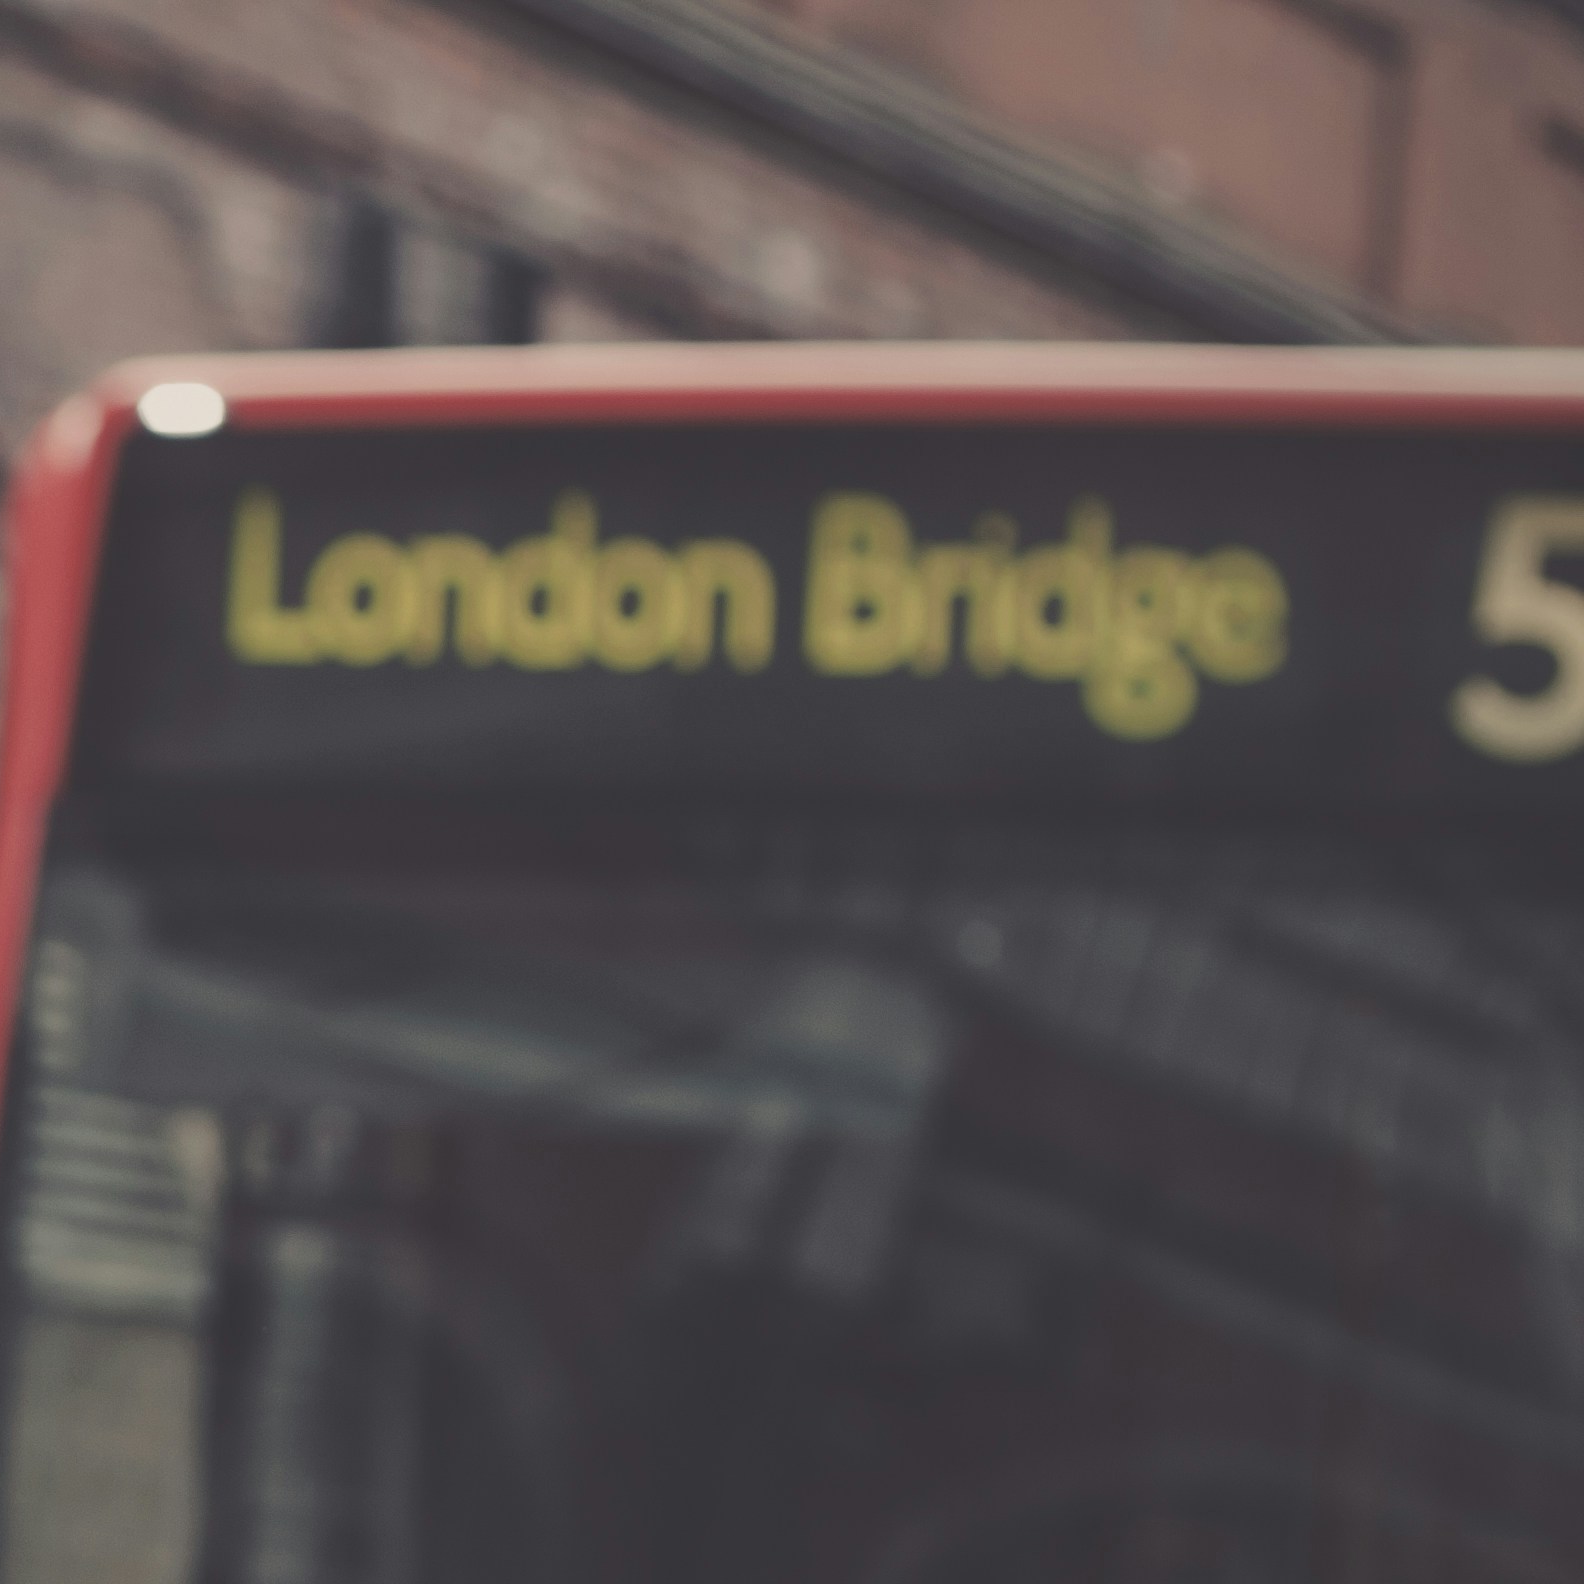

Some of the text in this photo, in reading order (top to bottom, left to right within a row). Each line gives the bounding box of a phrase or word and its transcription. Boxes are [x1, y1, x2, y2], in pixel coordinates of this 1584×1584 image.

[228, 486, 1288, 739] London Bridge
[1450, 494, 1584, 763] 5
